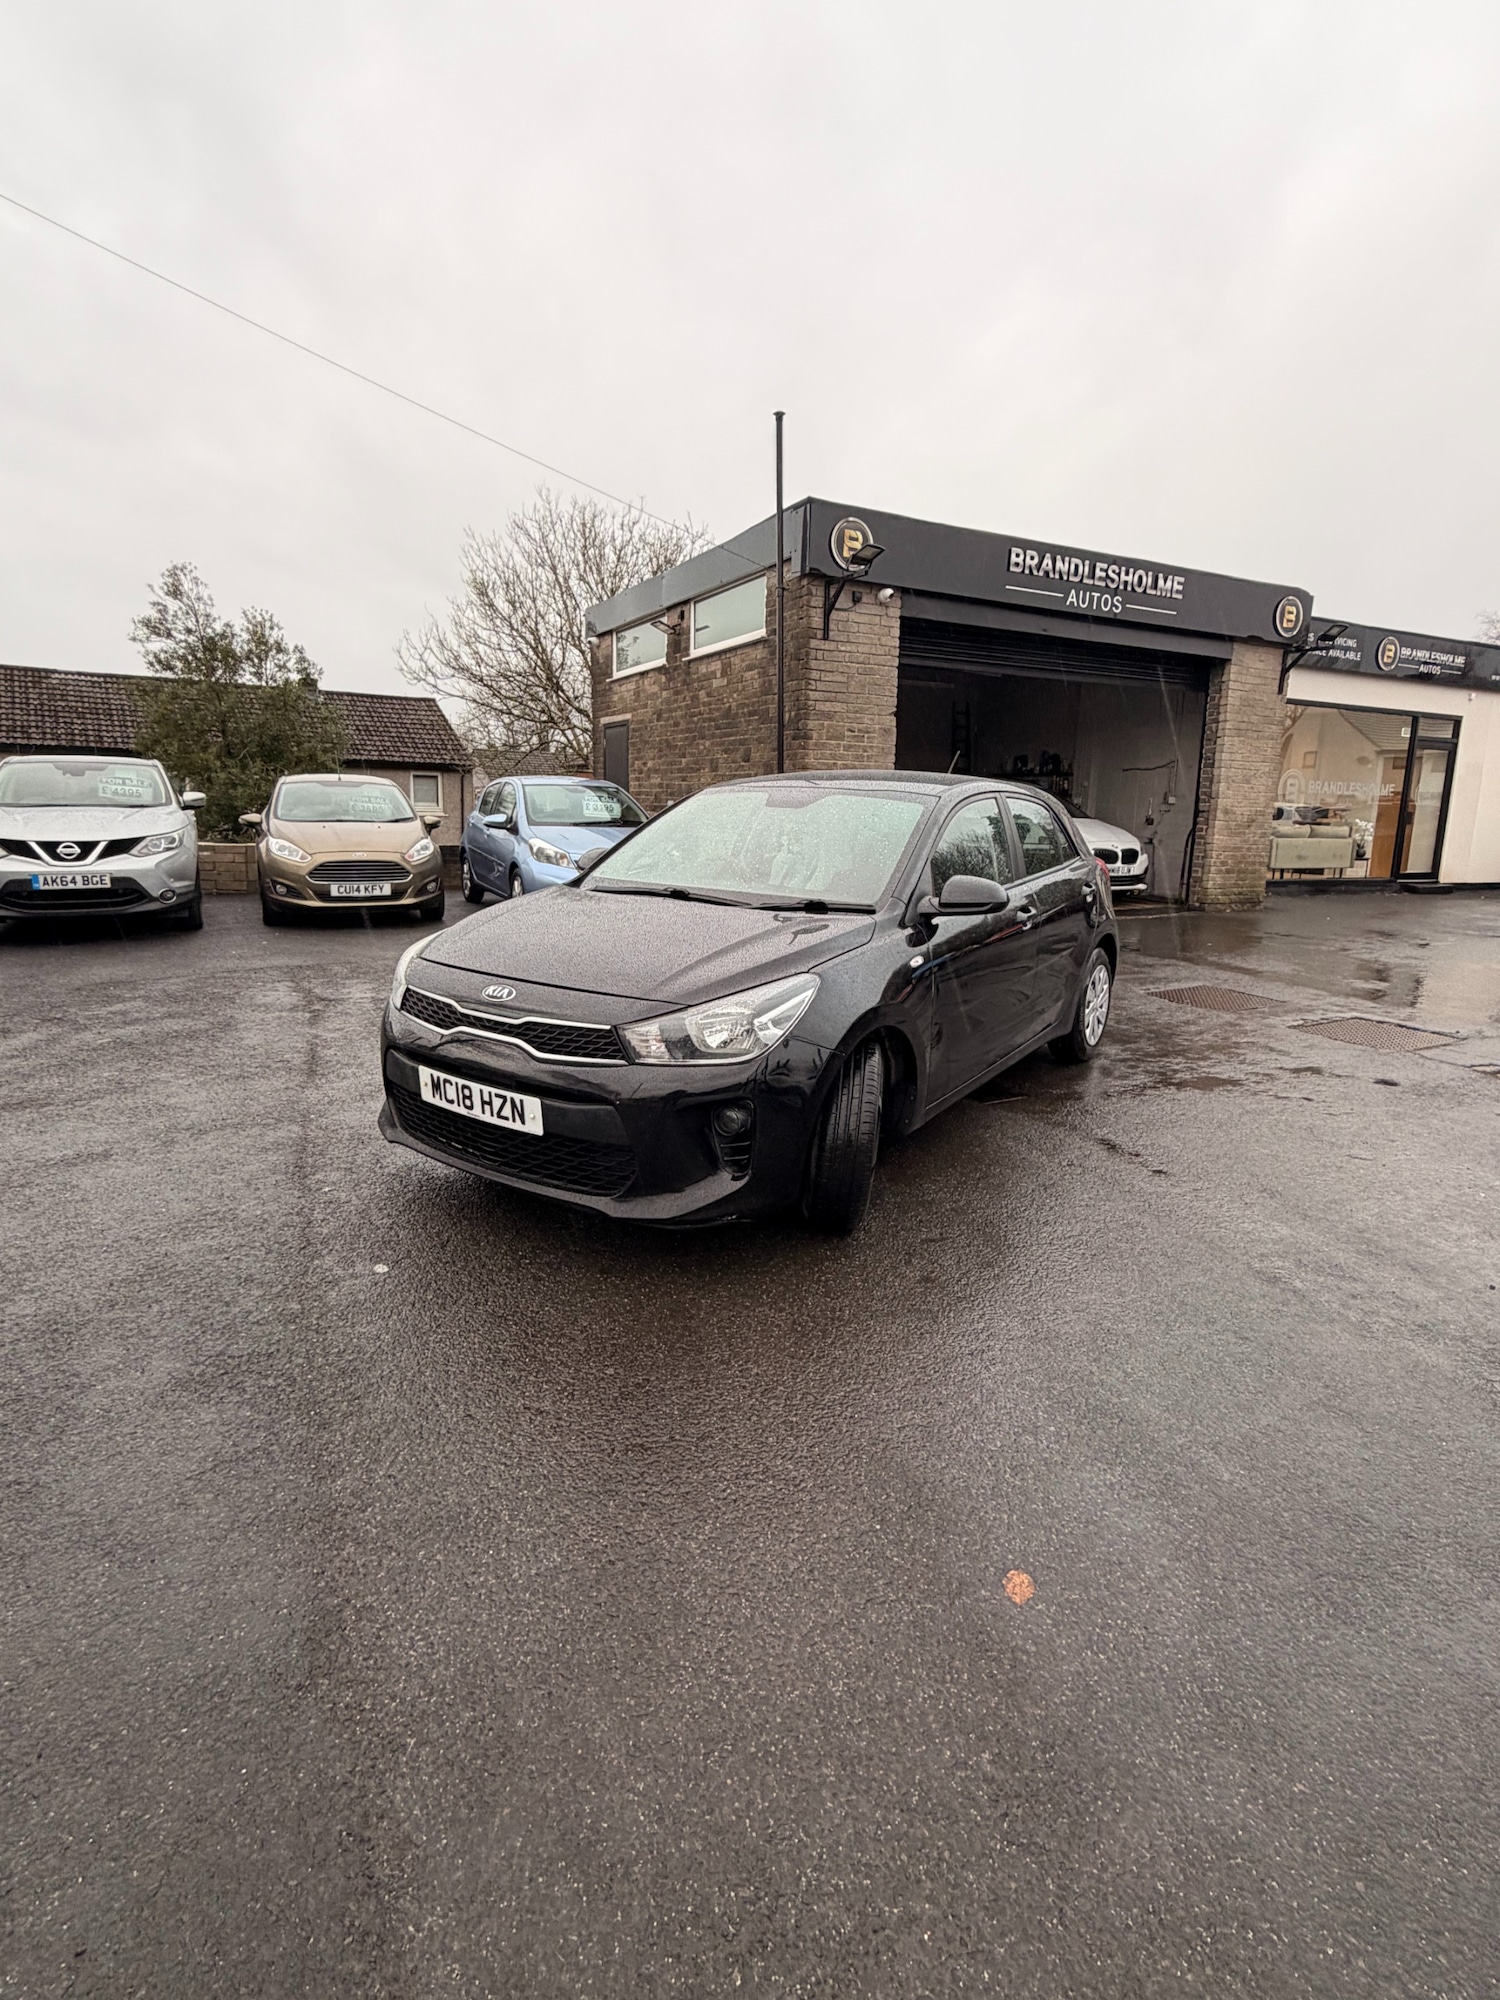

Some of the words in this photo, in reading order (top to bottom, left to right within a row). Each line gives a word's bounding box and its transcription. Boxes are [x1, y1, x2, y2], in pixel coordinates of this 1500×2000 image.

[1007, 546, 1186, 600] BRANDLESHOLME
[1066, 589, 1123, 614] AUTOS
[1328, 649, 1362, 661] AVAILABLE
[1400, 646, 1467, 668] BRANDLESHOLME
[1419, 664, 1441, 675] AUTOS
[42, 875, 77, 887] AK64
[81, 874, 108, 886] BGE
[337, 885, 361, 894] CU14
[364, 884, 384, 894] KFY
[485, 985, 510, 999] KIA
[430, 1073, 474, 1112] MC18
[480, 1088, 526, 1126] HZN
